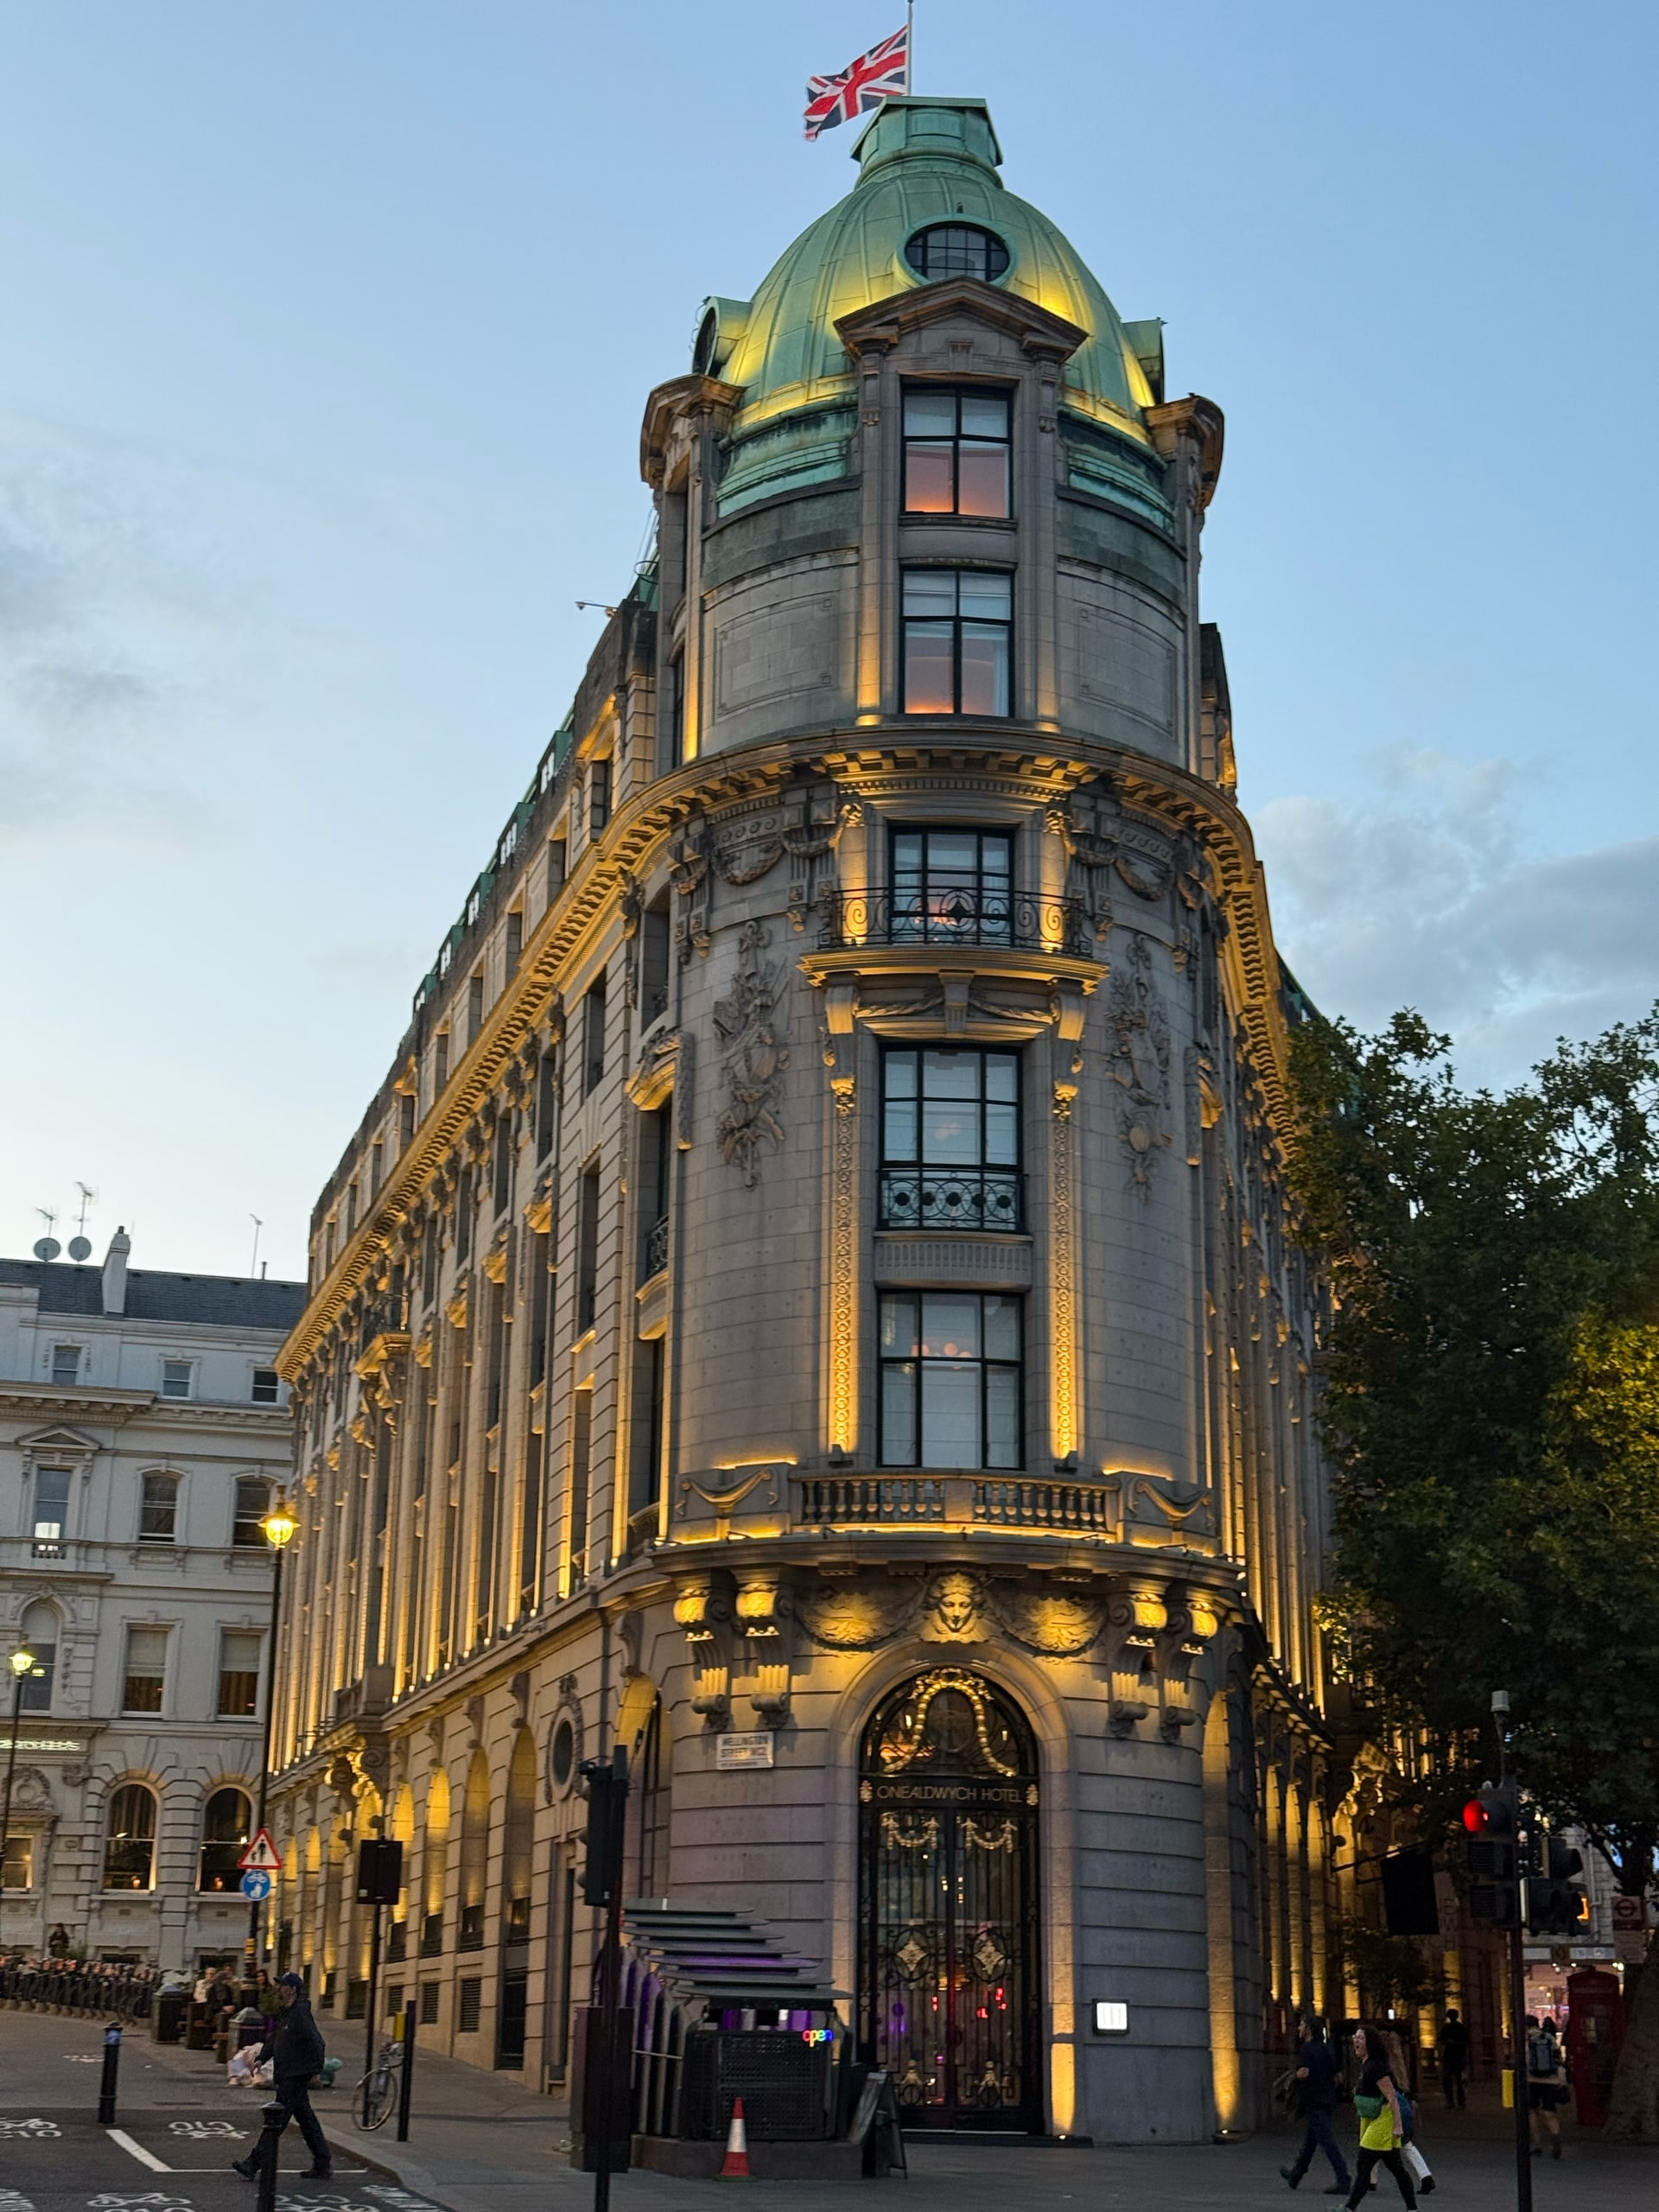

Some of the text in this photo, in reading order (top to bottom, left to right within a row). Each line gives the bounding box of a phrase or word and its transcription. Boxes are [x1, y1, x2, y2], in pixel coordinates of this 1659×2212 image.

[721, 1735, 769, 1746] WELLINGTON
[721, 1747, 749, 1758] STREET
[981, 1788, 1023, 1802] HOTEL
[802, 2029, 834, 2048] open
